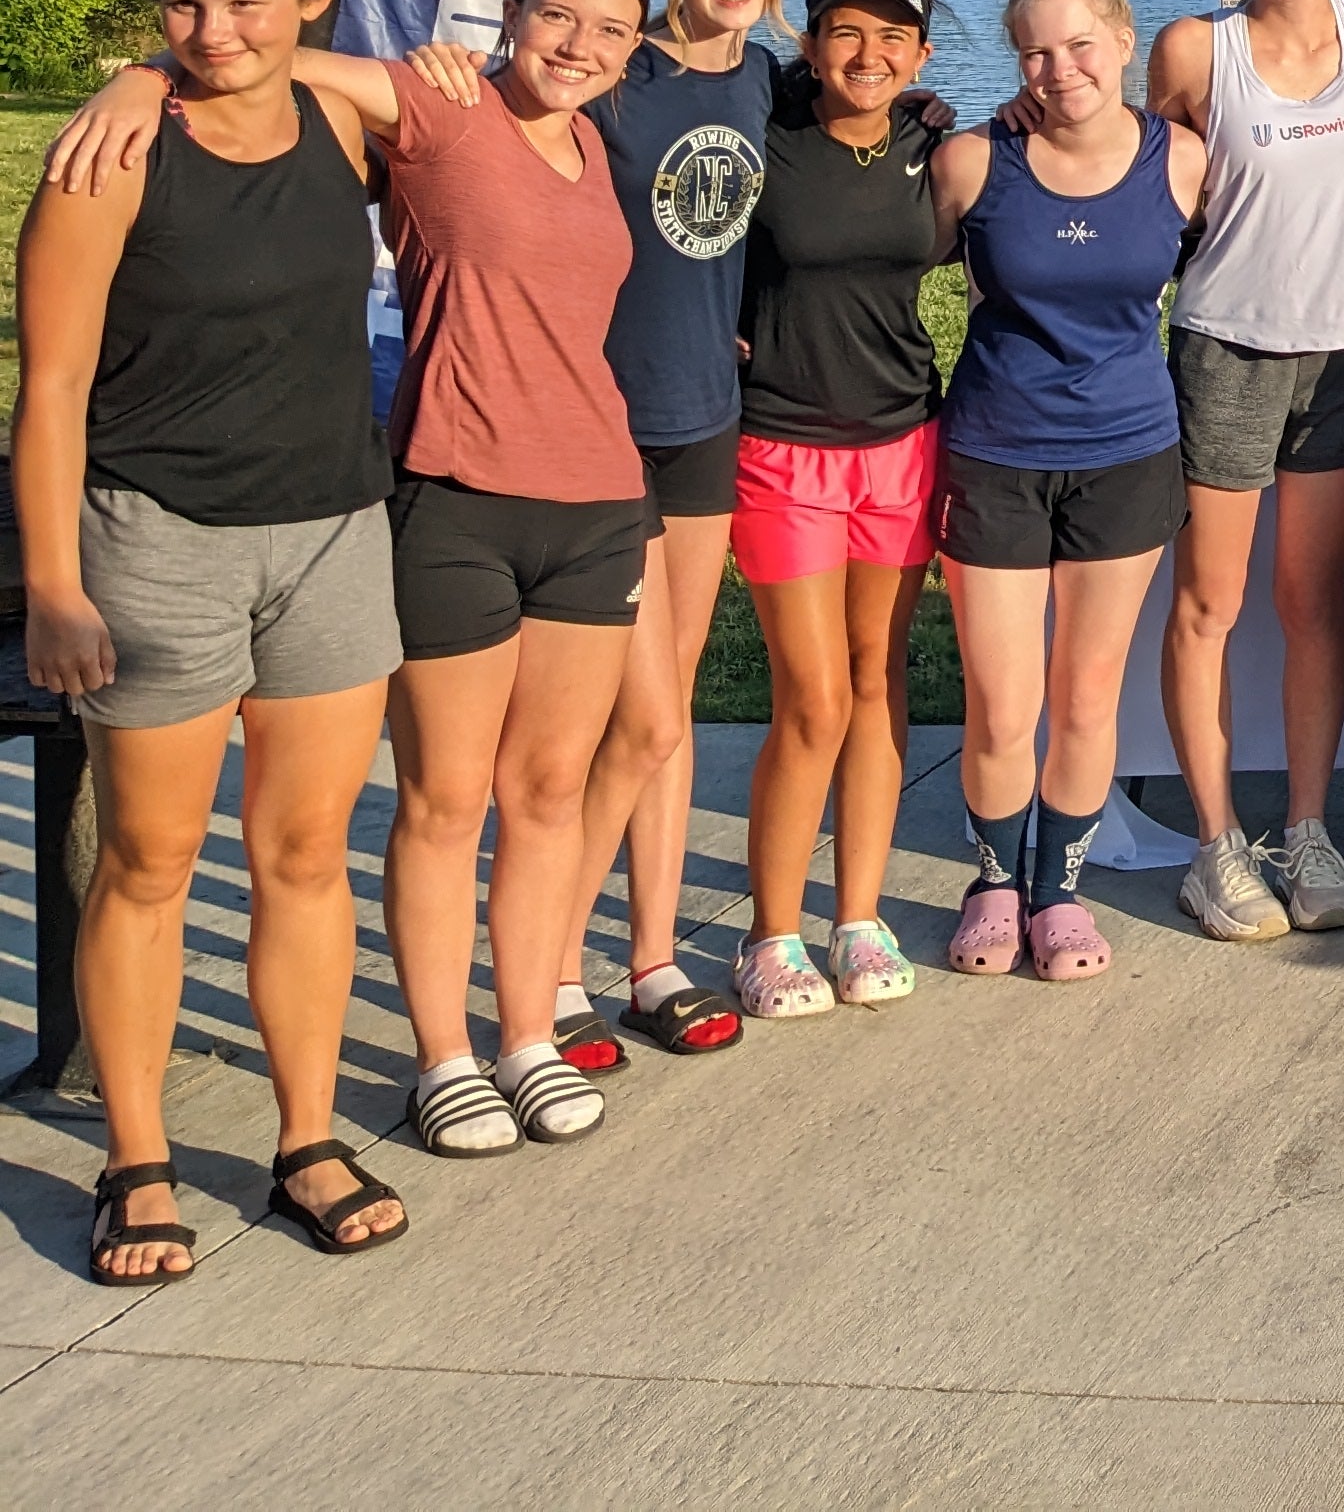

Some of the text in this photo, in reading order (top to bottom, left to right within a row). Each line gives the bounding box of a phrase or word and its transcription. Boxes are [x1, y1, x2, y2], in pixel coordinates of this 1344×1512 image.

[689, 130, 741, 151] ROWING
[695, 155, 733, 223] NC
[657, 199, 686, 242] STATE
